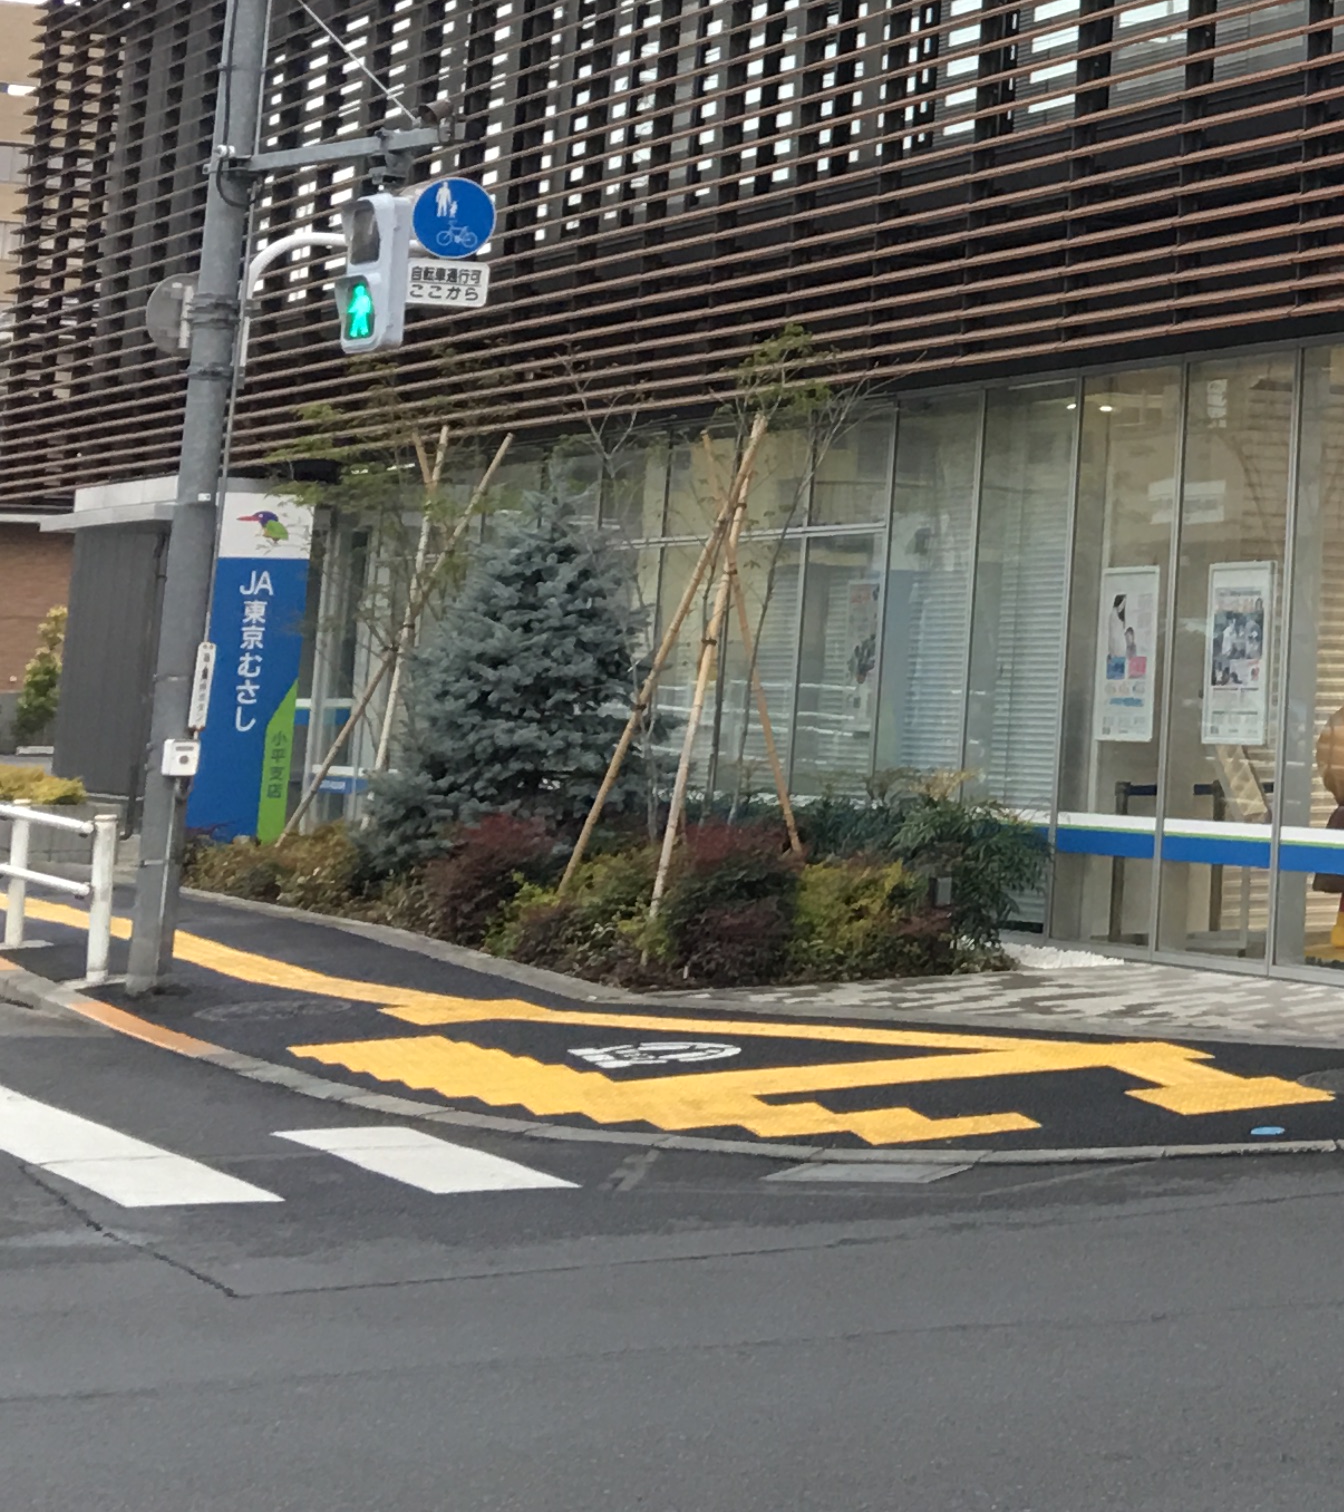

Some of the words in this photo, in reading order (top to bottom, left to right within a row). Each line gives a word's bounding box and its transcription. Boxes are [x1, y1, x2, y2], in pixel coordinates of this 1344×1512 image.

[410, 284, 479, 301] ここから
[411, 266, 482, 284] 自転車通行可
[235, 570, 274, 732] JA東京むさし
[266, 730, 287, 798] 小平支店
